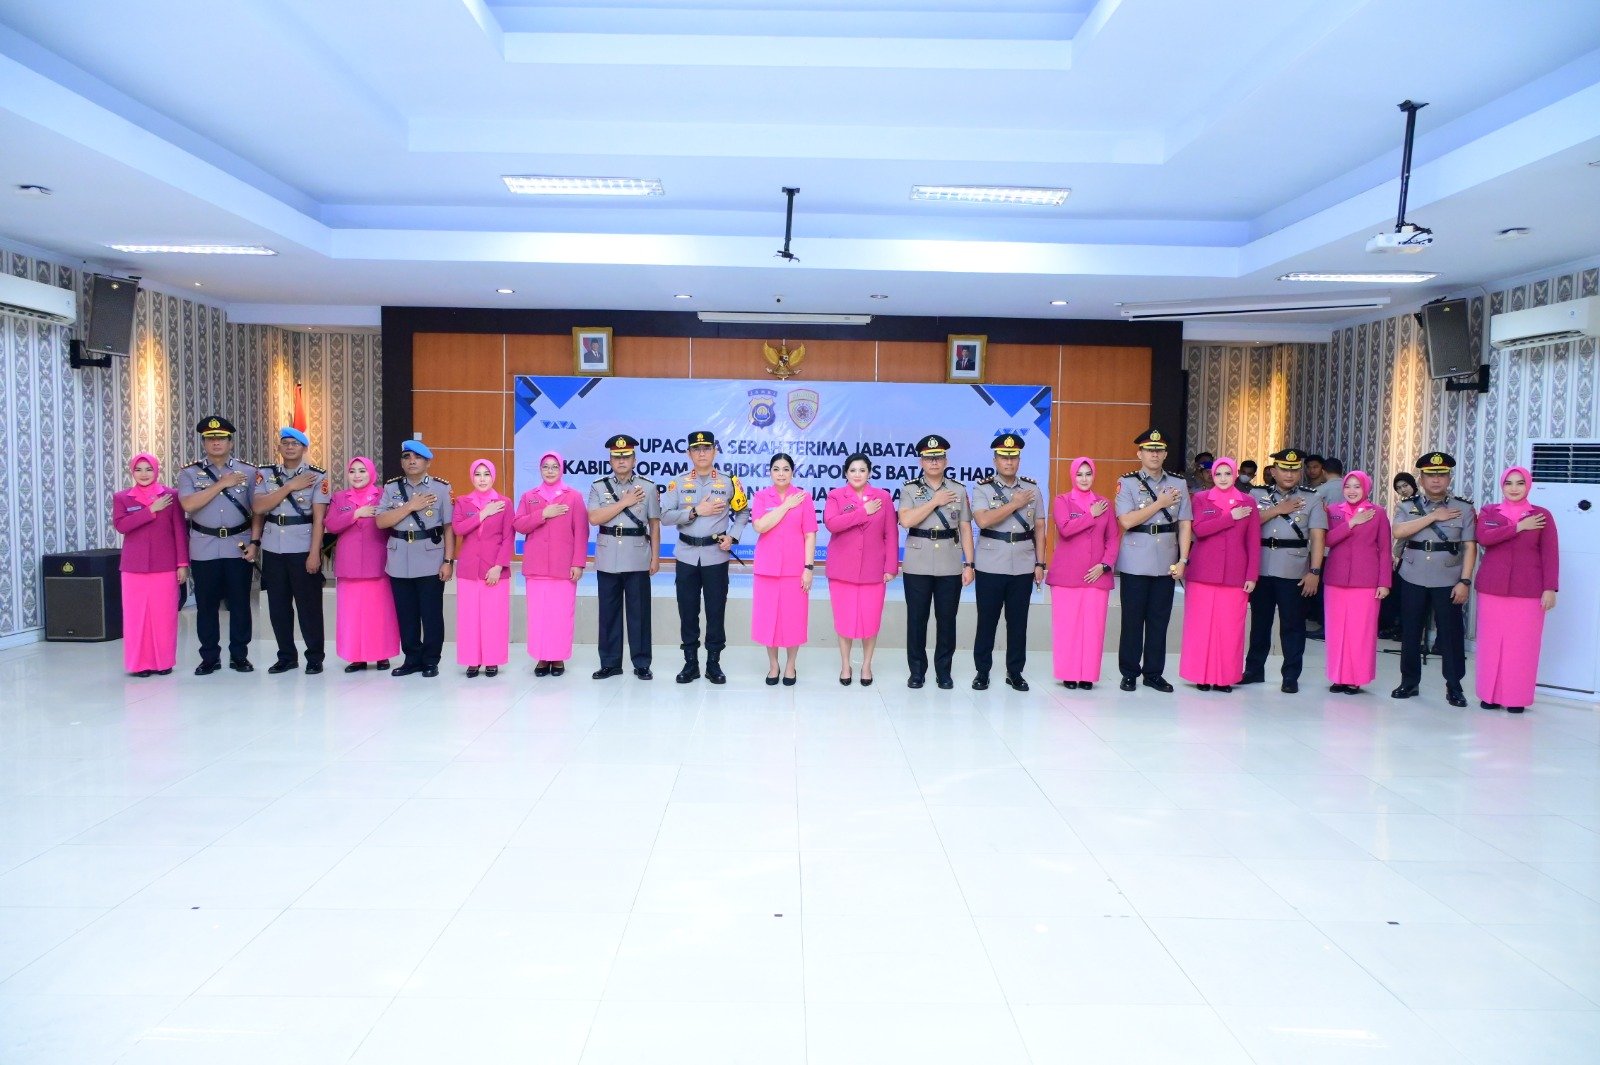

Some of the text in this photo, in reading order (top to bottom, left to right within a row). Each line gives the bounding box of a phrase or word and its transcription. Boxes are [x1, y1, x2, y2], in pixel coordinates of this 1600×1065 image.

[640, 438, 921, 457] UPACA SERAH TERIMA JABATA
[886, 465, 956, 480] BATG
[960, 467, 998, 481] HAR
[735, 548, 755, 556] Jamb
